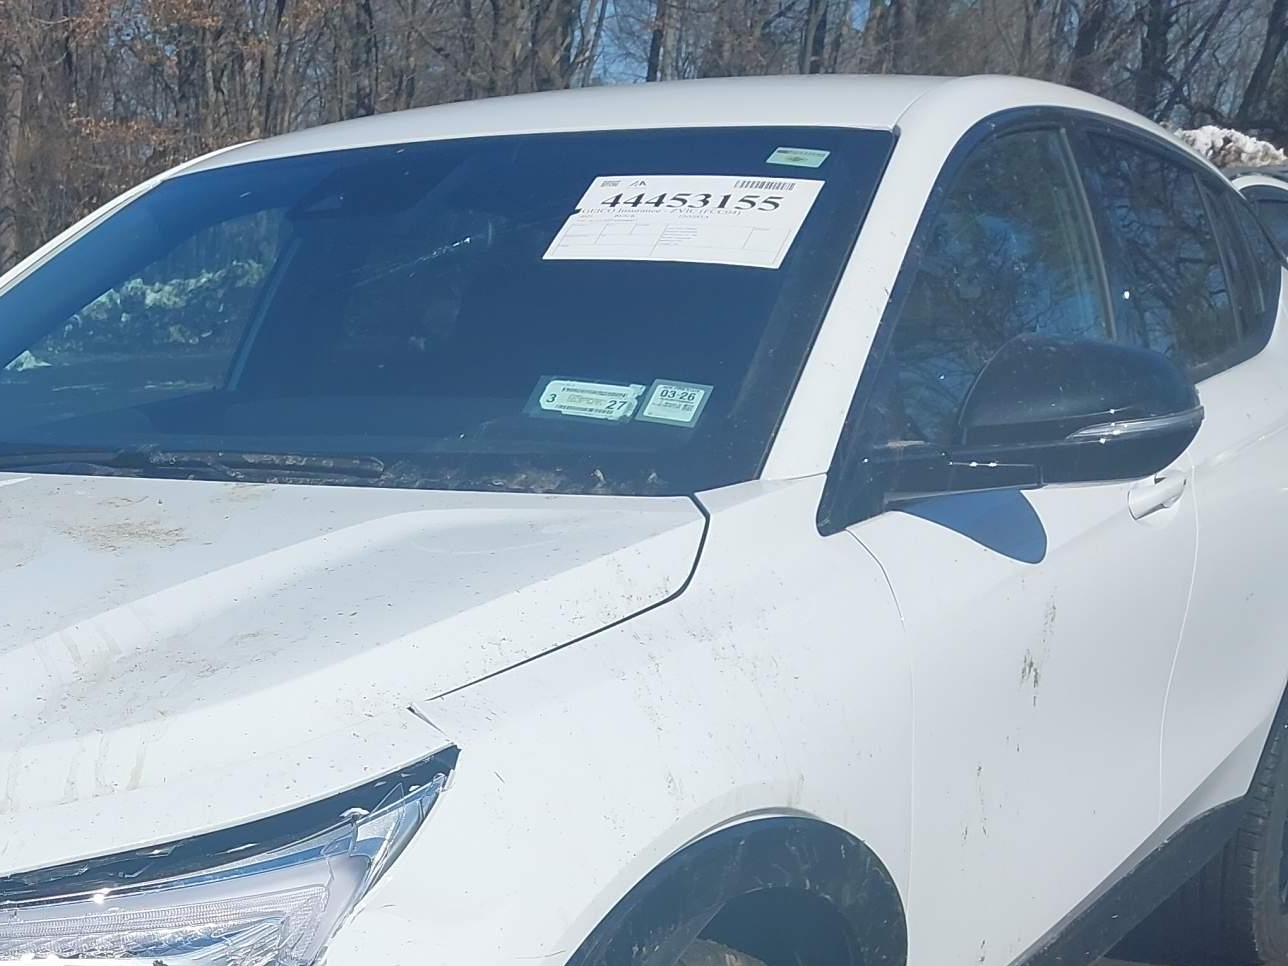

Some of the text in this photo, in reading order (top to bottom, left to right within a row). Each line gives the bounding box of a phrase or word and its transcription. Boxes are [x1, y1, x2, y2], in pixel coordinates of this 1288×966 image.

[601, 193, 784, 211] 44453155
[546, 393, 557, 403] 3
[606, 399, 628, 411] 27
